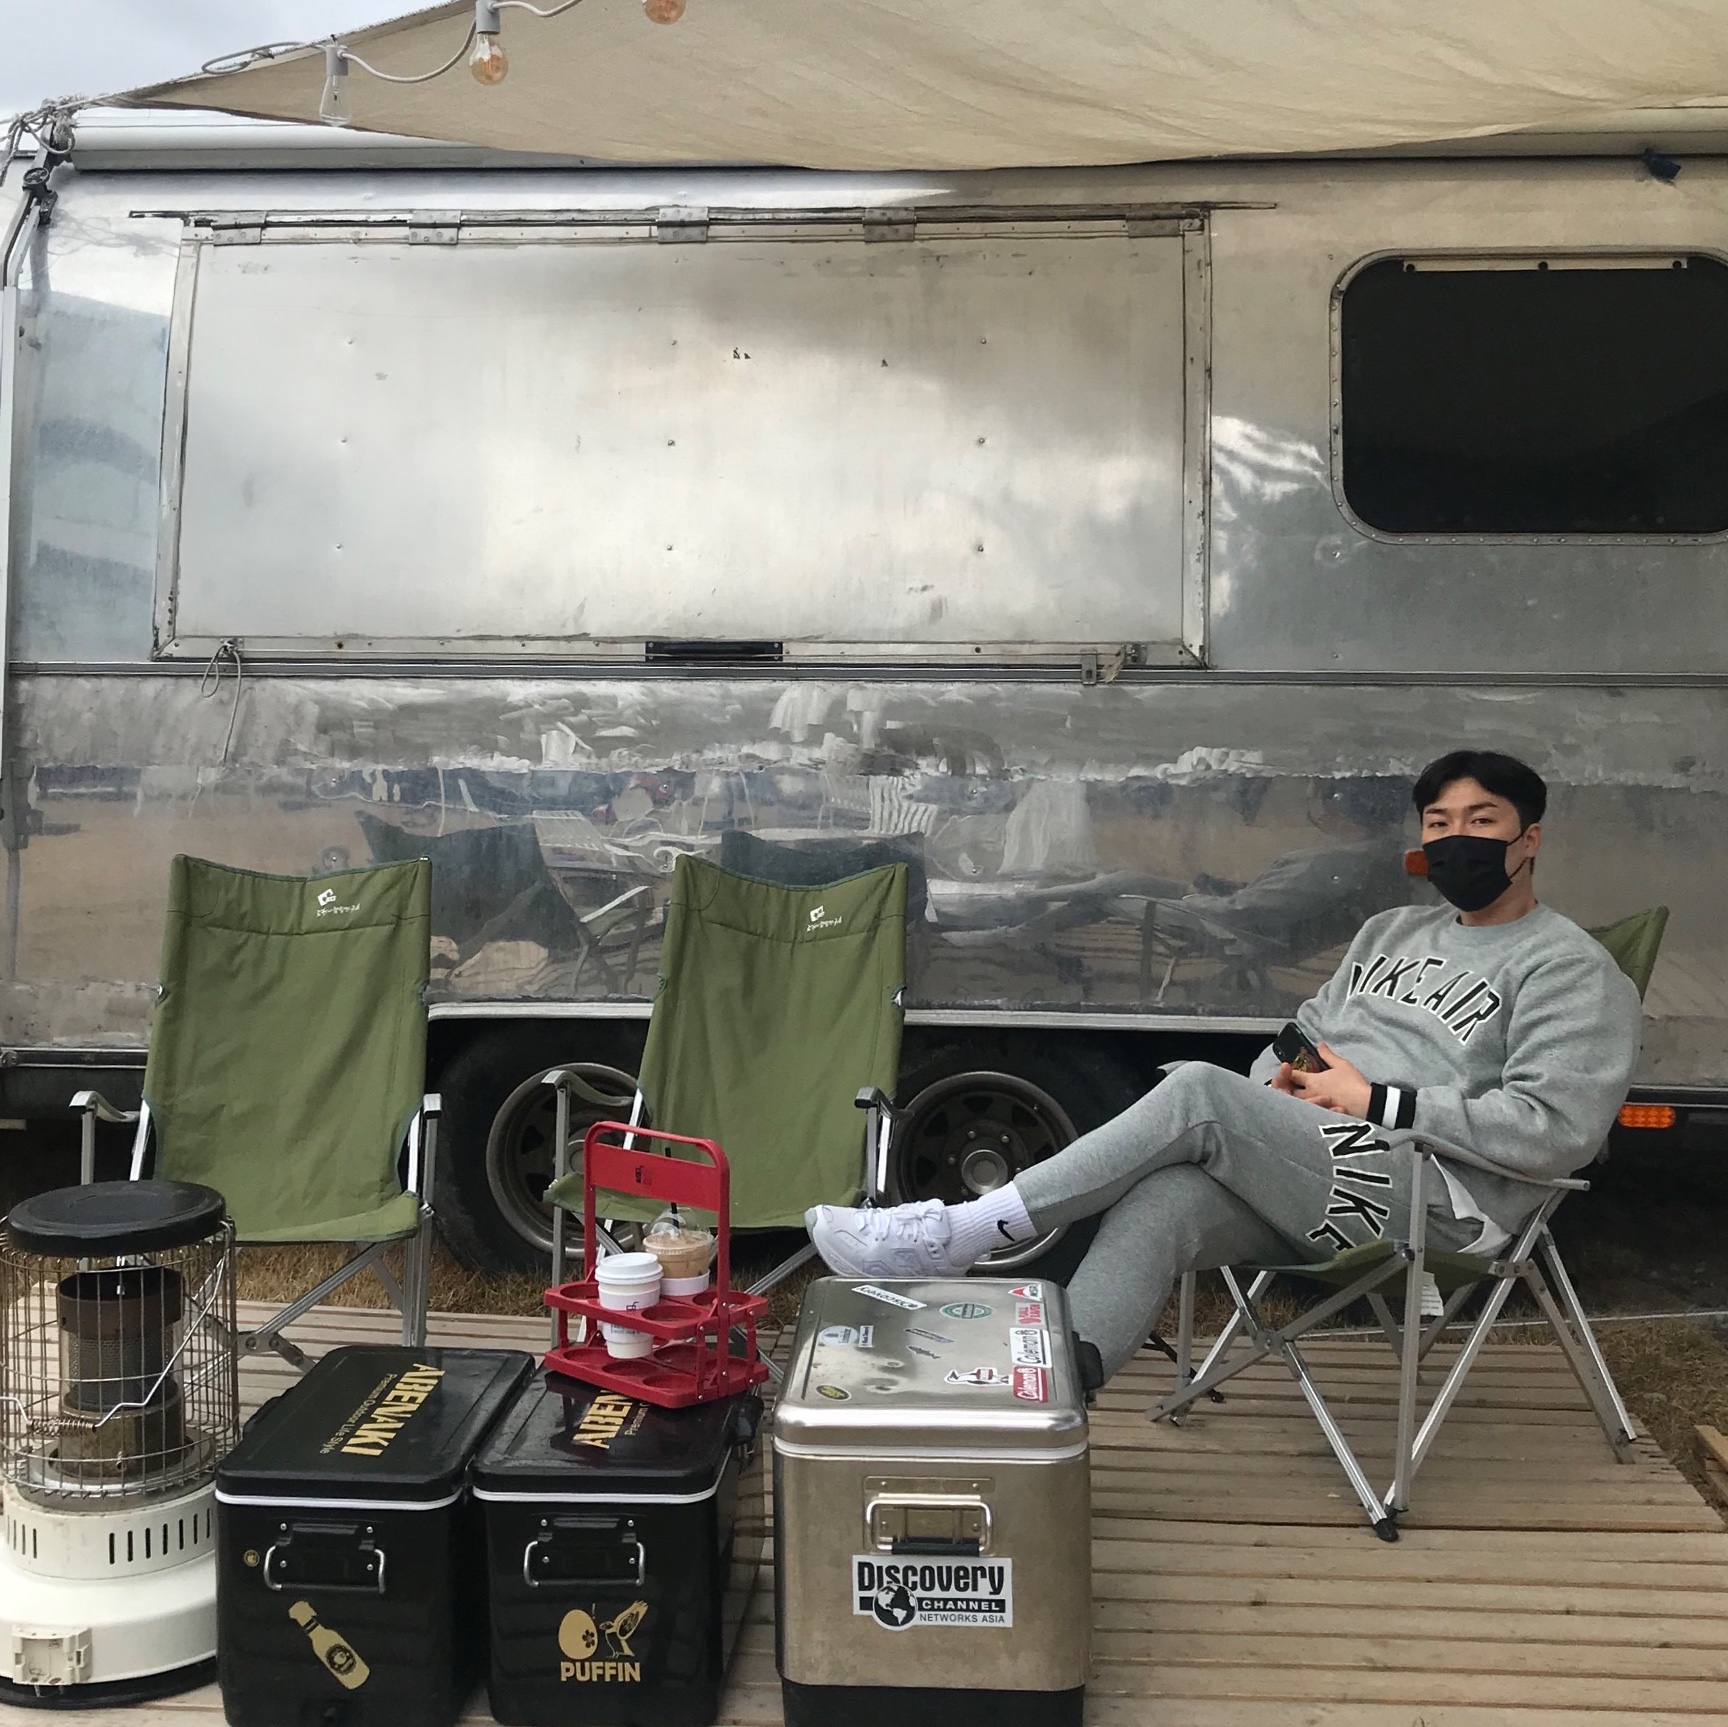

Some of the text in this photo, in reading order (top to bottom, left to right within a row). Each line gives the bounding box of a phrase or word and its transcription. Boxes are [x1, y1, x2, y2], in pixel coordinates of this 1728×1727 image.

[1421, 970, 1502, 1046] AIR
[1017, 1335, 1042, 1364] Coleman
[1017, 1374, 1038, 1399] Coleman
[341, 1363, 446, 1456] ABENAKI
[571, 1389, 633, 1449] ABEN
[624, 1407, 649, 1435] Premium
[335, 1424, 356, 1437] Life
[320, 1436, 344, 1455] Style
[857, 1561, 1005, 1595] Discovery
[919, 1613, 1005, 1623] NETWORKS ASIA
[922, 1600, 1000, 1610] CHANNEL
[560, 1661, 641, 1682] PUFFIN
